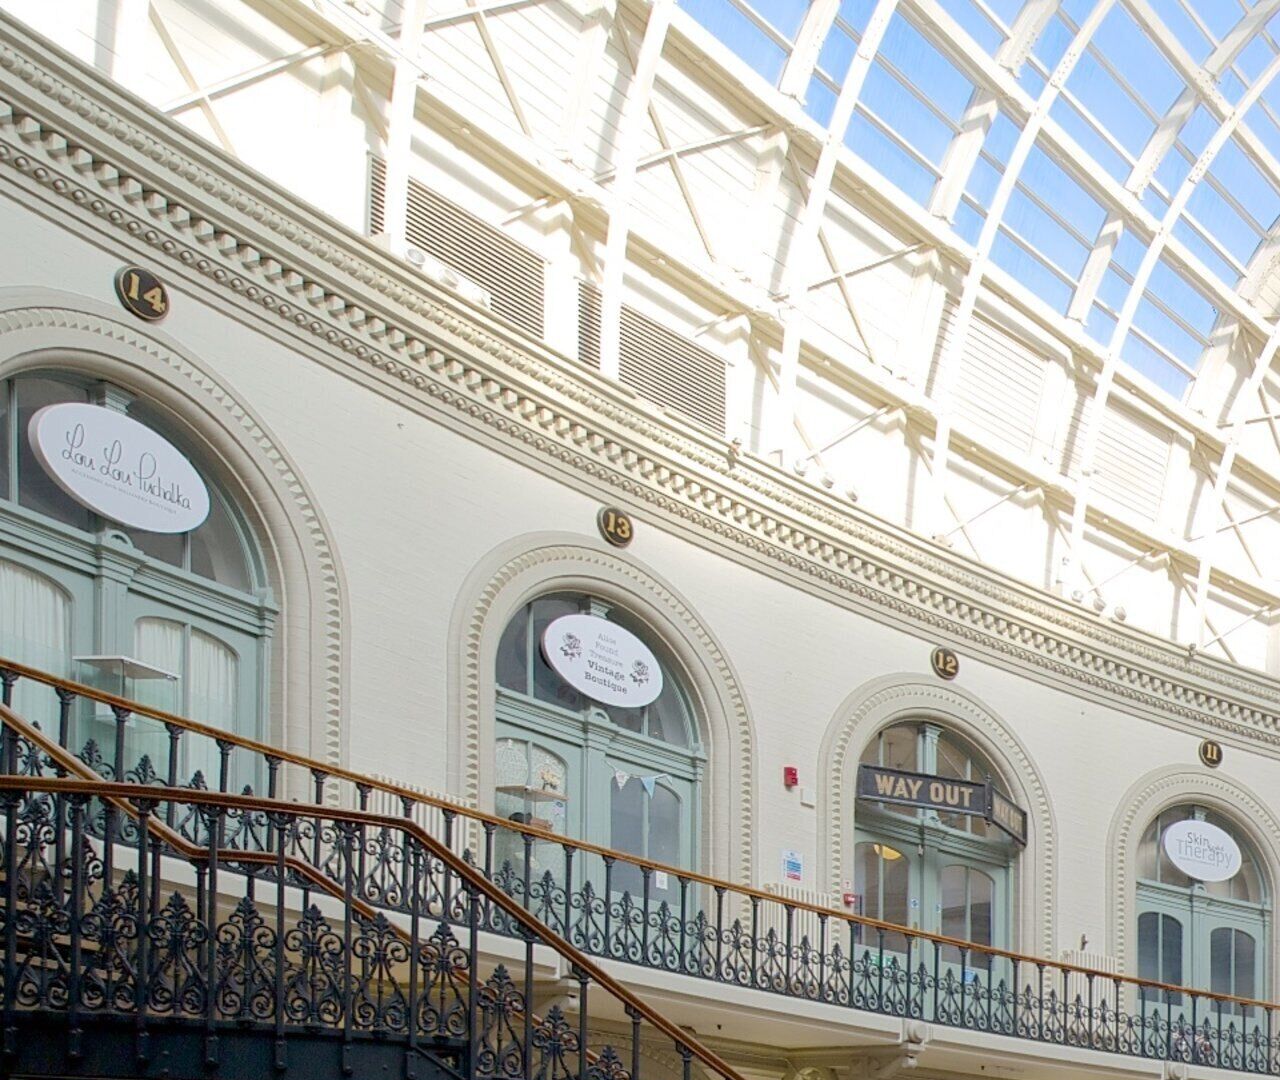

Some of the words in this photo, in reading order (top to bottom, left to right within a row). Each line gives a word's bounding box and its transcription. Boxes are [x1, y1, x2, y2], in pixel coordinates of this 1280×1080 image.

[129, 272, 165, 313] 14
[62, 423, 95, 471] Lou
[99, 440, 133, 486] Lou
[607, 511, 630, 539] 13
[587, 659, 625, 681] Vintage
[937, 651, 957, 674] 12
[584, 671, 628, 694] Boutique
[1206, 743, 1218, 761] 11
[874, 773, 924, 799] WAY
[930, 782, 974, 808] OUT
[1187, 831, 1210, 846] Skin
[1175, 838, 1233, 870] Therapy
